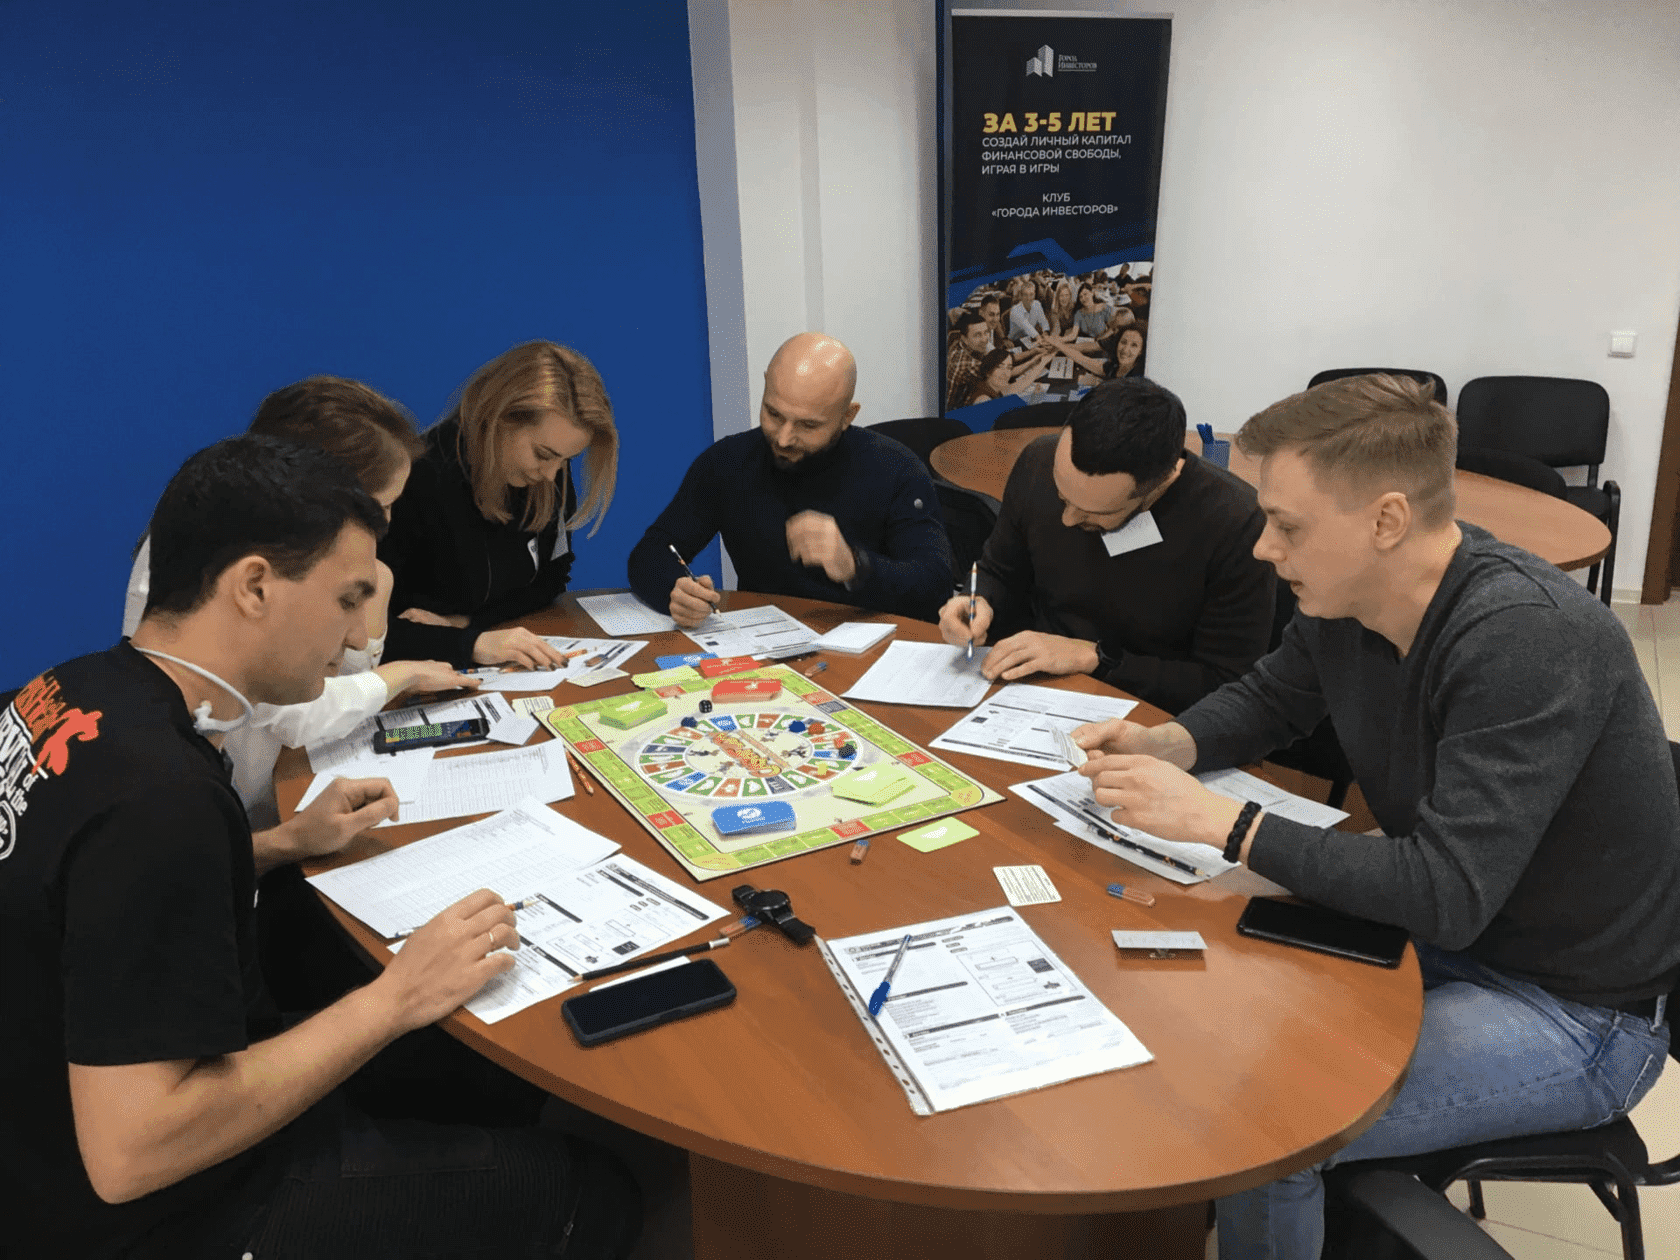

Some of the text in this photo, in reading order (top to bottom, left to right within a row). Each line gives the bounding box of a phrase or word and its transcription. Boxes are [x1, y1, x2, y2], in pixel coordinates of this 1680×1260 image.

[983, 112, 1116, 133] ЗА 3-5 ЛЕТ
[982, 133, 1132, 148] СОЗДАЙ ЛИЧНЫЙ КАПИТАЛ
[982, 148, 1121, 161] ФИНАНСОВОЙ СВОБОДЫ,
[981, 163, 1060, 175] ИГРАЯ В ИГРЫ
[1042, 192, 1071, 203] КЛУБ
[991, 204, 1118, 218] «ГОРОДА ИНВЕСТОРОВ»
